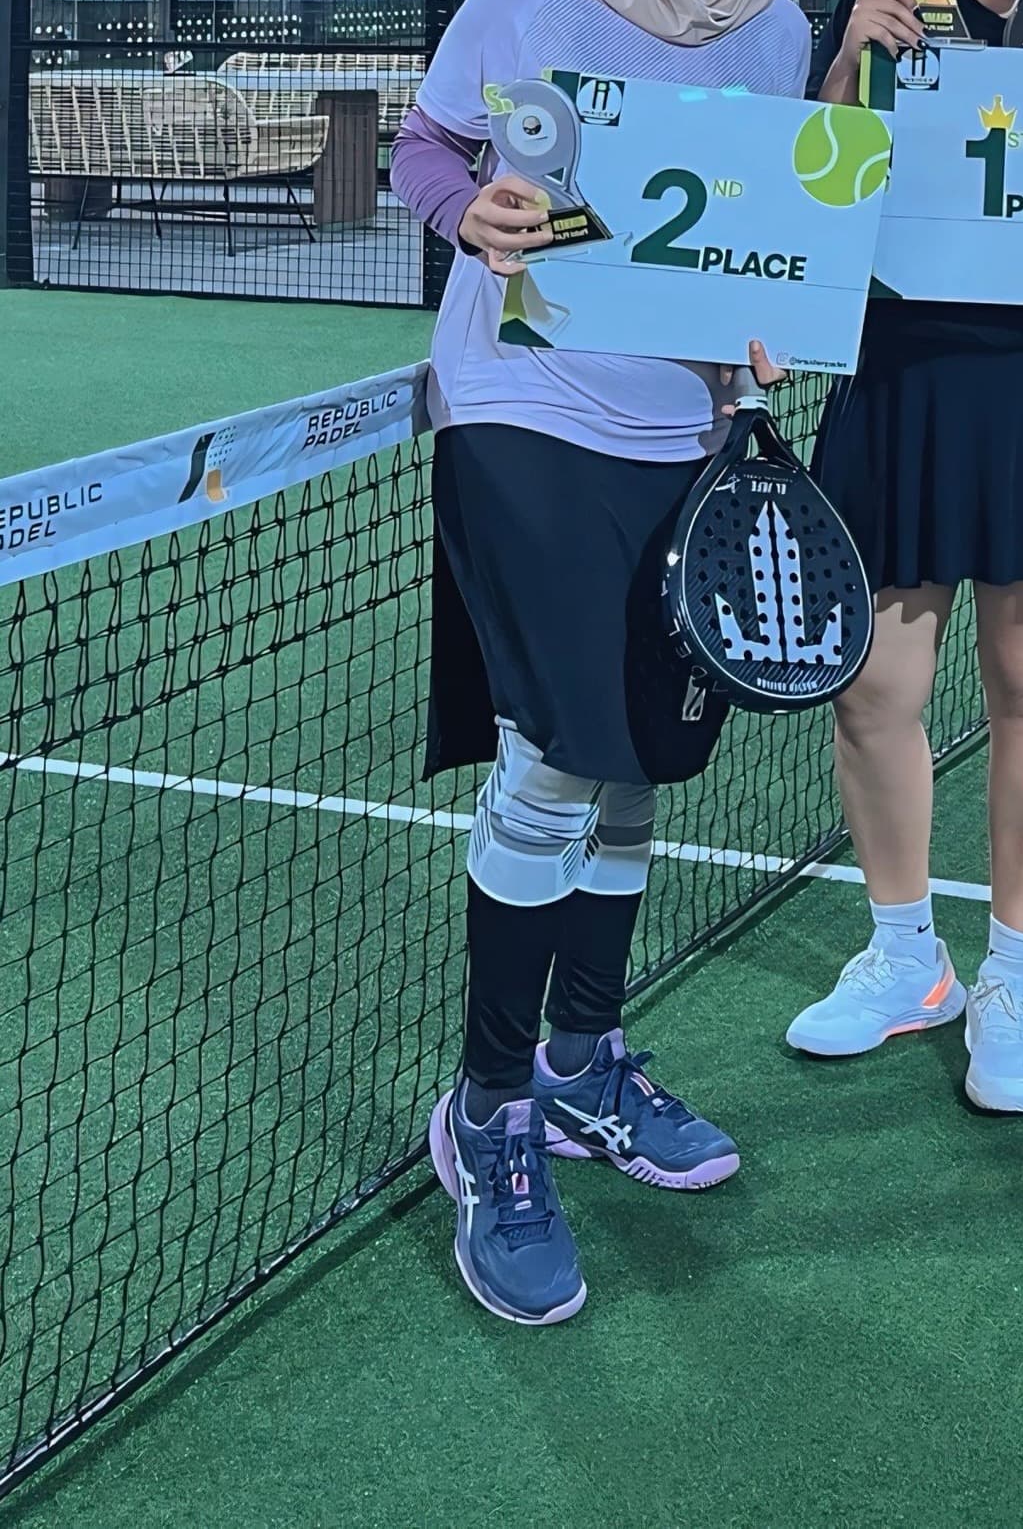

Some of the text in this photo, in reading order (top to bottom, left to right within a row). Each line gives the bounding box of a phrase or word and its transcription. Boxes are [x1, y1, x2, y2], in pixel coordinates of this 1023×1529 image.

[701, 246, 807, 281] PLACE
[308, 390, 397, 433] REPUBLIC
[302, 421, 362, 450] PADEL
[0, 520, 56, 550] DEL
